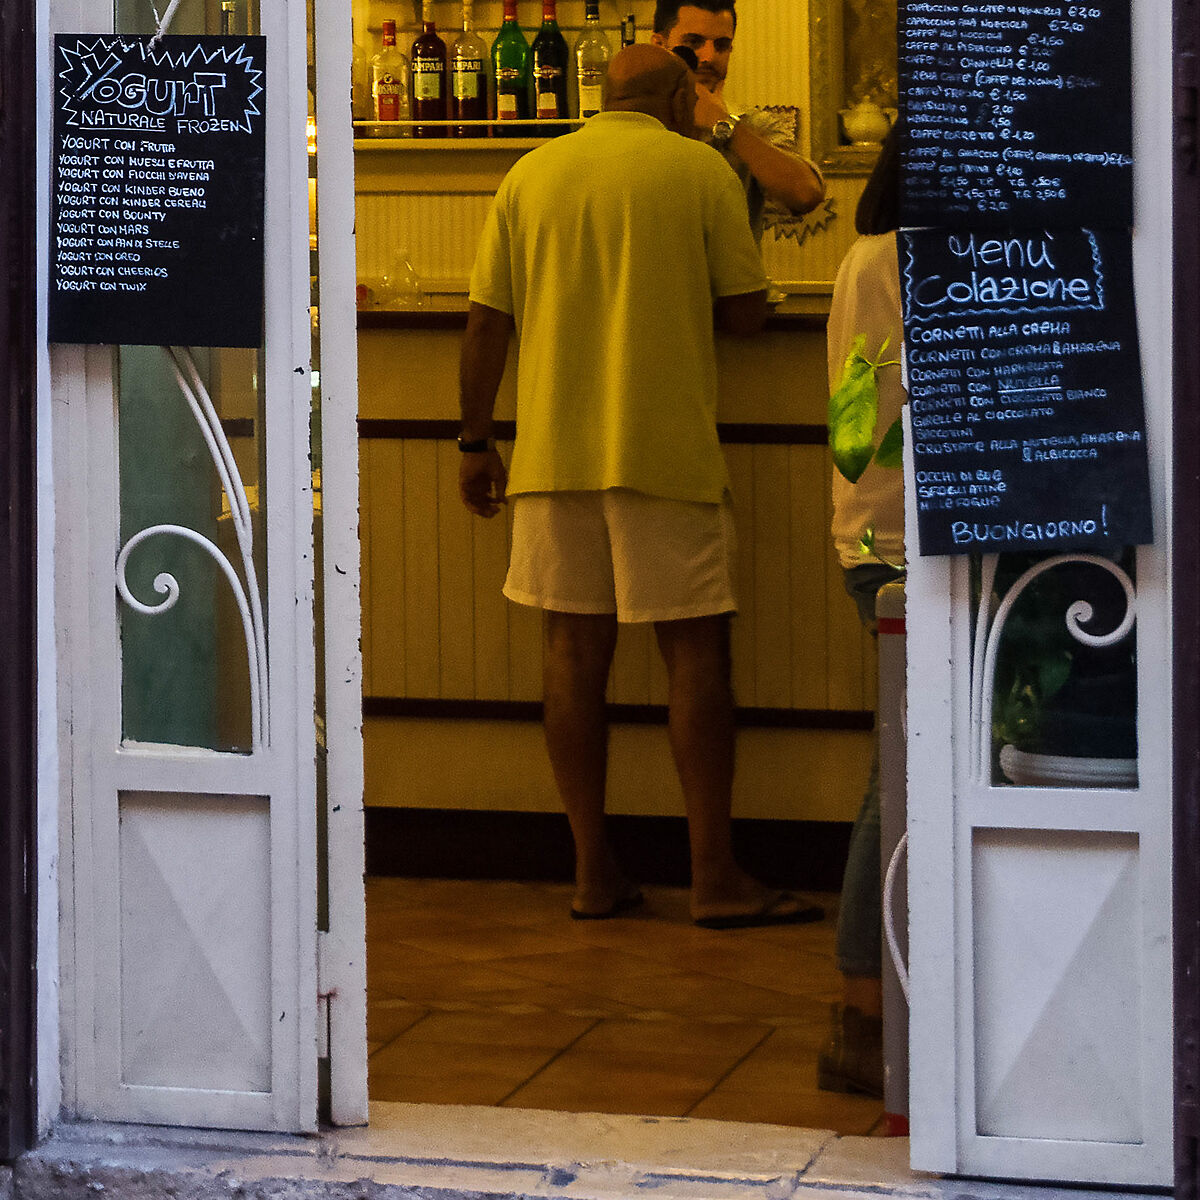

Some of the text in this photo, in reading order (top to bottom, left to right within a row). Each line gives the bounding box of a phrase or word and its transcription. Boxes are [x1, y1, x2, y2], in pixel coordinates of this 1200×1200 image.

[81, 109, 240, 134] NATURALE FROZEN
[61, 134, 111, 150] YOGURT
[114, 139, 136, 151] CON
[59, 154, 100, 166] YOGURT
[104, 155, 125, 165] CON
[58, 167, 100, 179] YOGURT
[103, 169, 124, 179] CON
[128, 170, 166, 181] FIOCCHI
[58, 181, 205, 197] YOGURT CON KINDER BUENO
[57, 194, 96, 206] YOGURT
[99, 196, 119, 205] CON
[122, 197, 161, 208] KINDER
[99, 210, 120, 219] CON
[123, 211, 166, 222] BOUNTY
[57, 222, 149, 235] YOGURT CON MARS
[57, 236, 94, 248] YOGURT
[97, 239, 114, 248] CON
[145, 239, 180, 249] STELLE
[57, 250, 141, 262] YOGURT CON OREO
[95, 266, 115, 276] CON
[117, 267, 169, 277] CHEERIOS
[56, 279, 147, 292] YOGURT CON TWIX
[913, 271, 1091, 308] Colazione
[989, 323, 1018, 338] ALLA
[970, 395, 994, 407] CON
